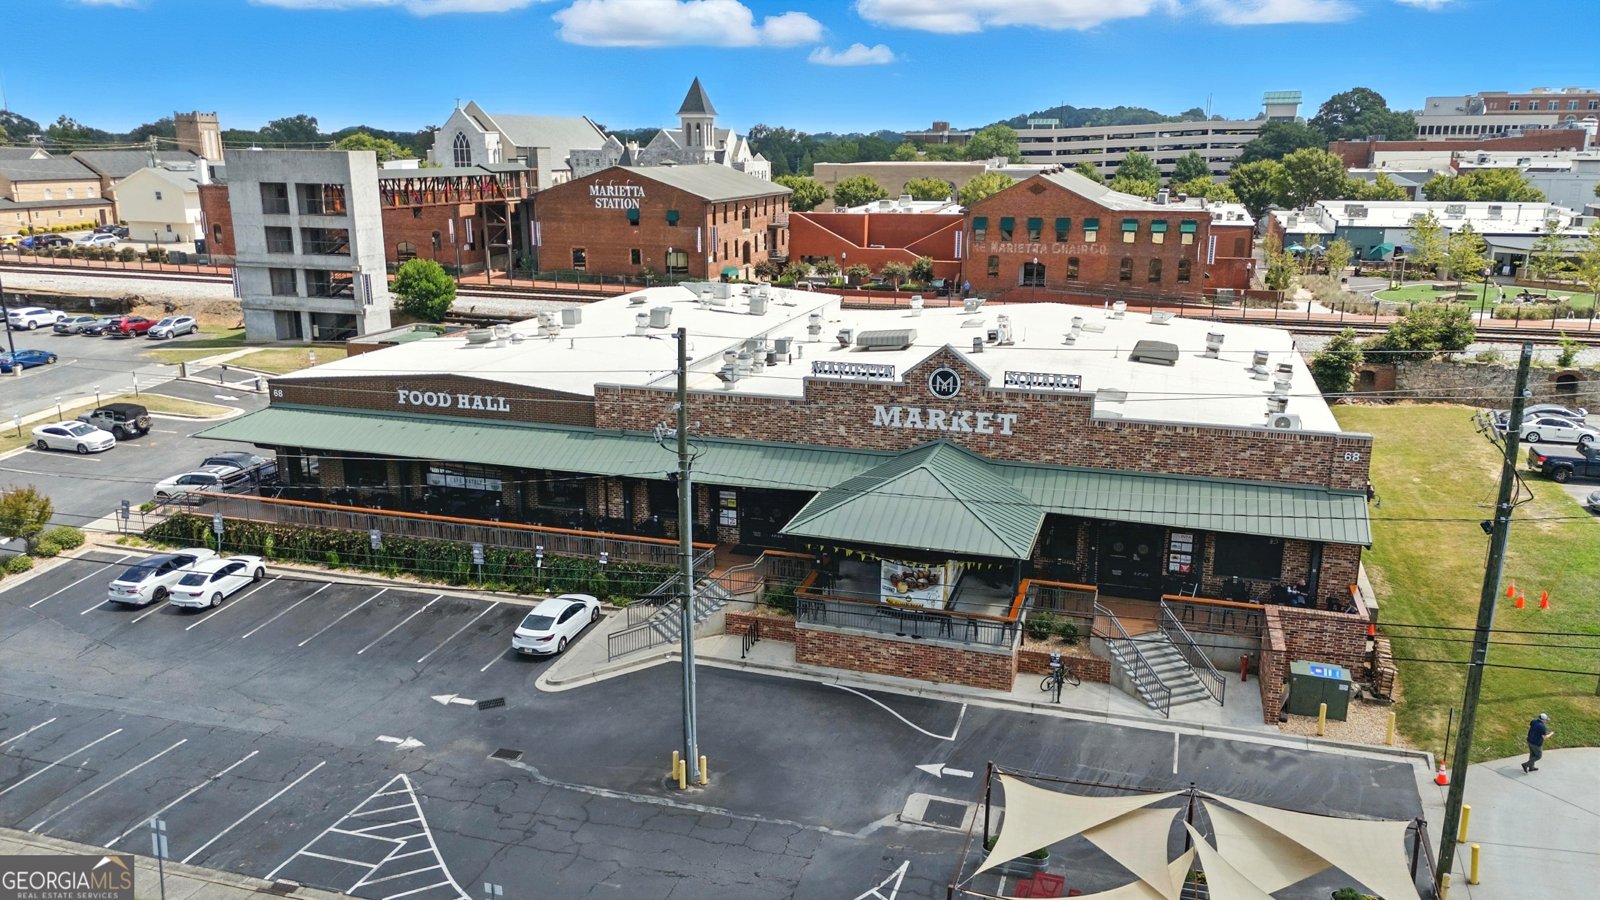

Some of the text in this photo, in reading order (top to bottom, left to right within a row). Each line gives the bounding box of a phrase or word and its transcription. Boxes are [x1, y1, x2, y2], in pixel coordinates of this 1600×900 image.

[589, 185, 646, 197] MARIETTA
[595, 197, 640, 209] STATION
[811, 361, 894, 378] MARIETTA
[1007, 372, 1079, 389] SQUARE
[273, 389, 284, 398] 68
[397, 388, 510, 412] FOOD HALL
[872, 405, 1018, 436] MARKET
[1344, 451, 1360, 462] 68
